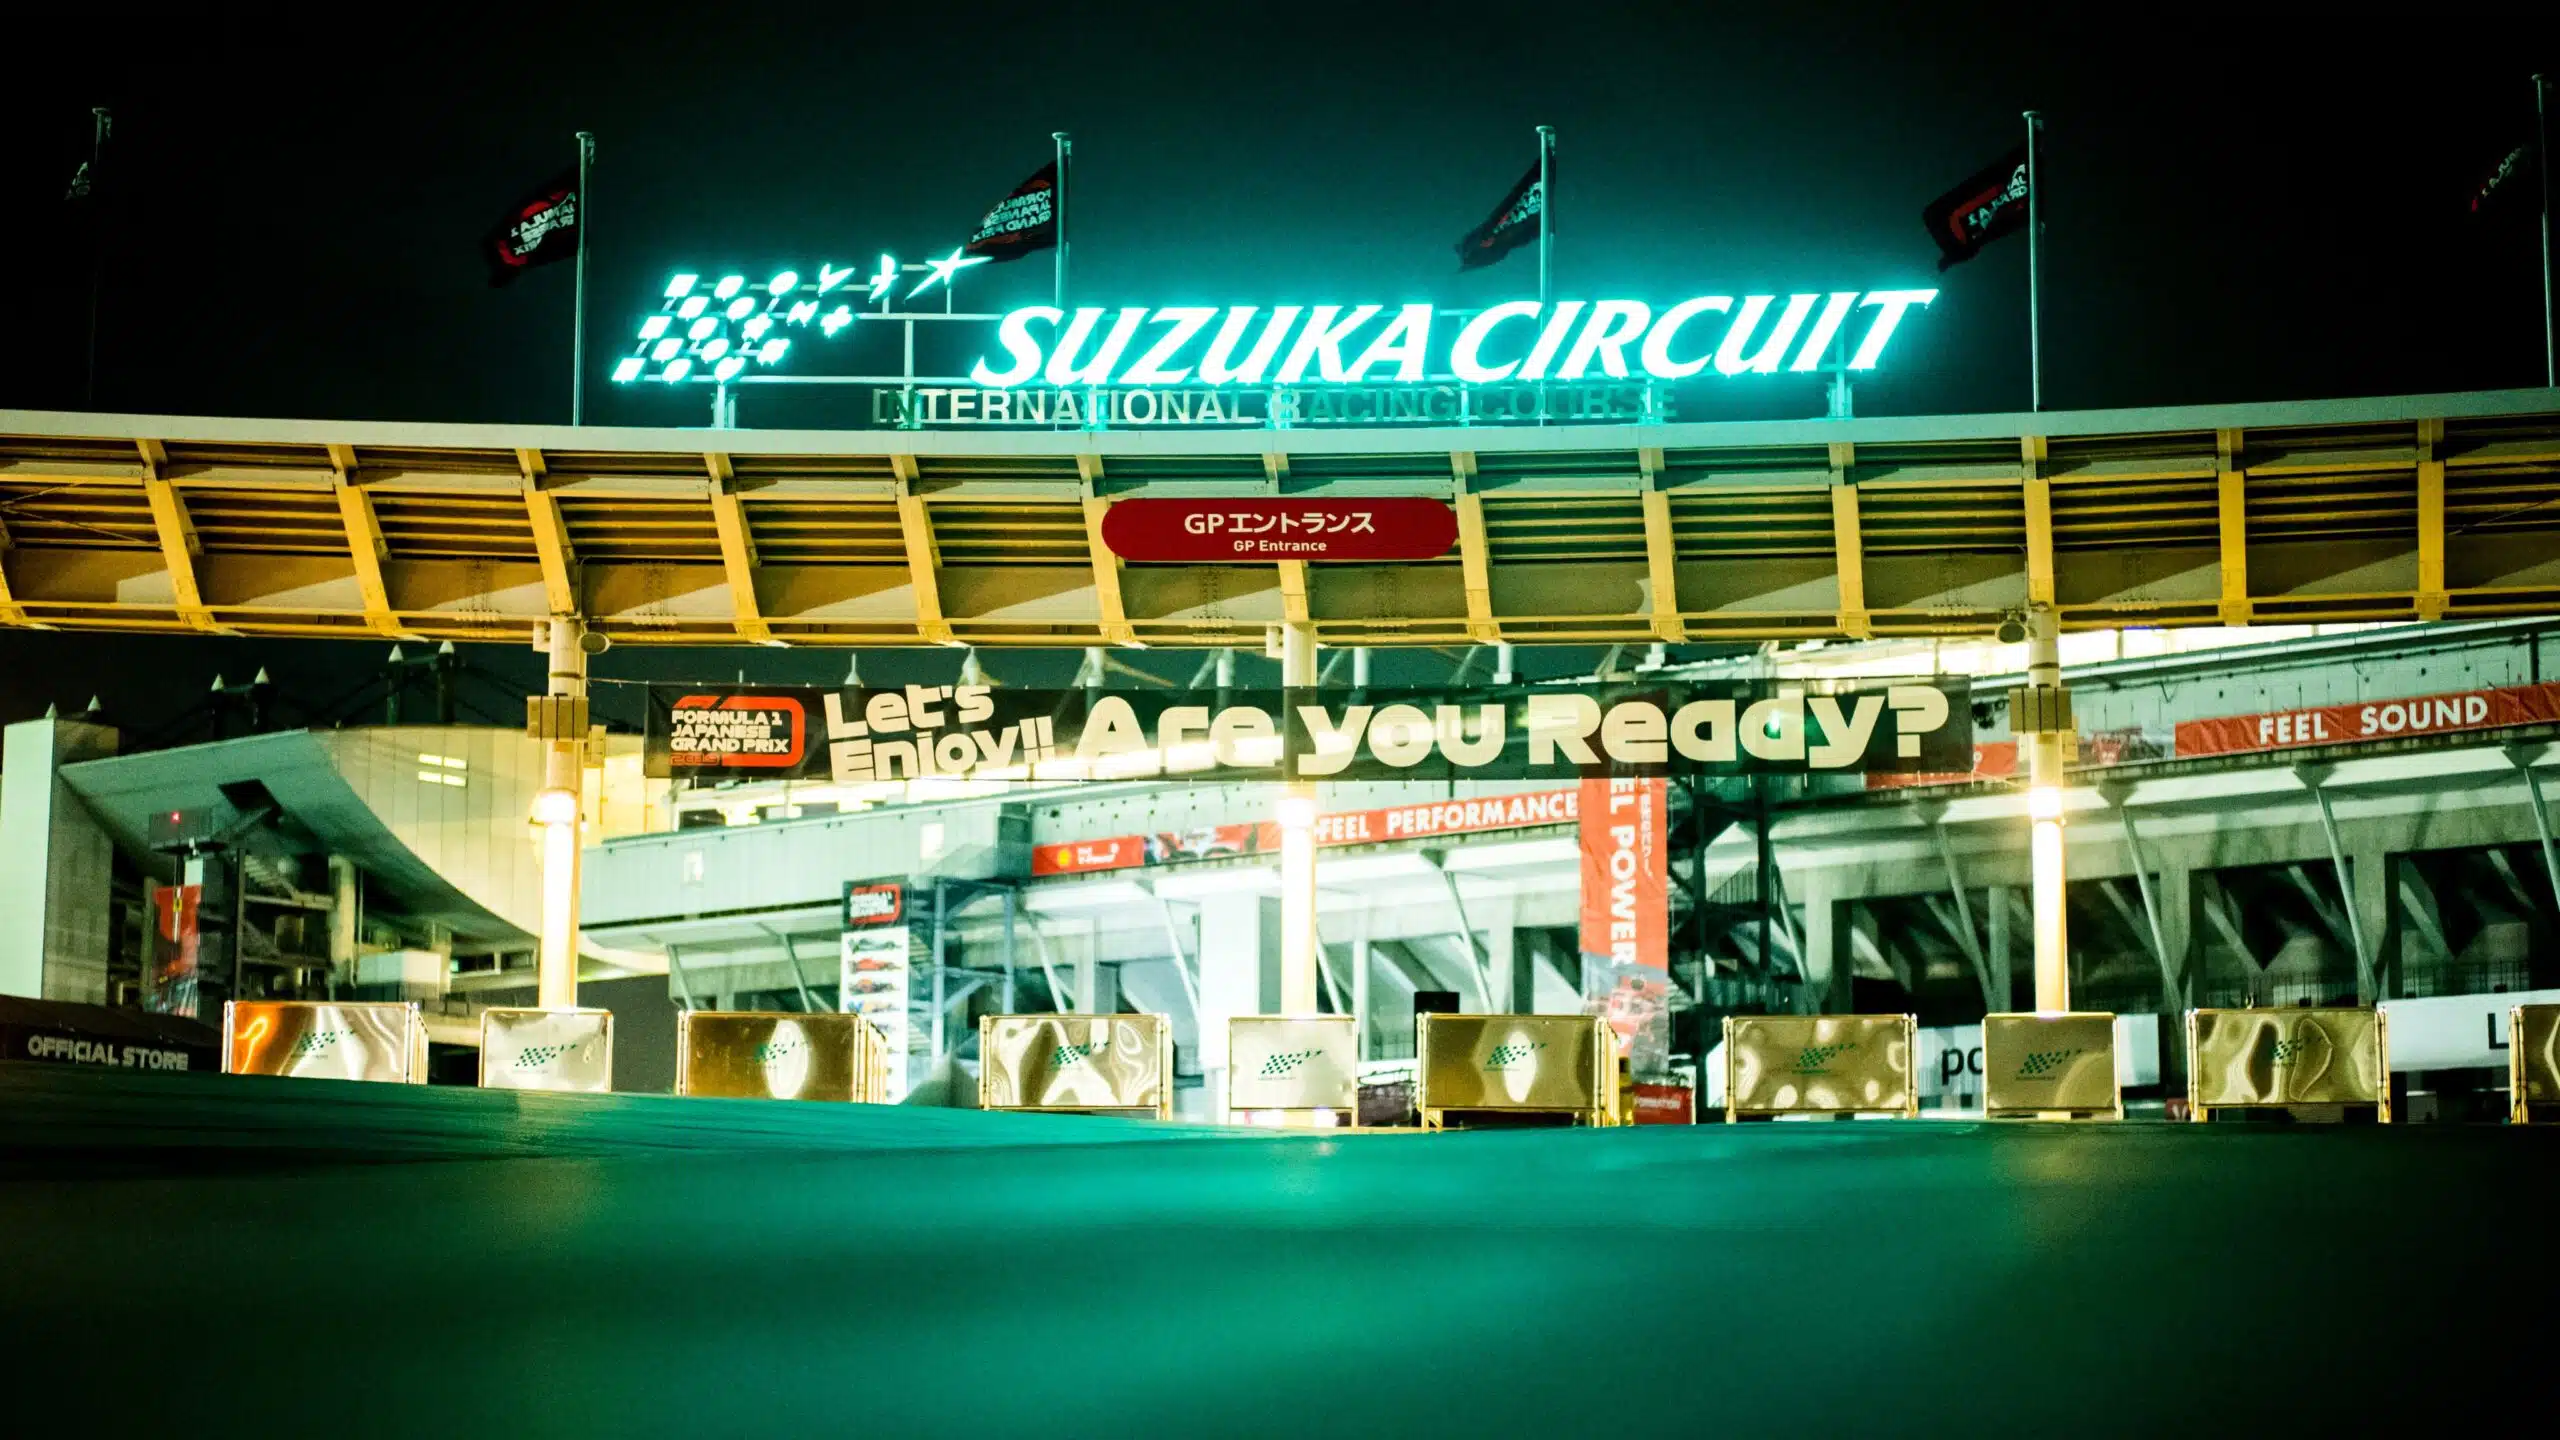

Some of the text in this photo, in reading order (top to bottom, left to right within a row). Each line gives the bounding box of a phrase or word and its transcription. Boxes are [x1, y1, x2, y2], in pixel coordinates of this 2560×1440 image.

[970, 288, 1940, 388] SUZUKA CIRCUIT
[872, 381, 1678, 425] INTERNATIONAL RACING COURSE
[1233, 540, 1328, 553] GP Entrance
[671, 710, 783, 726] FORMULA 1
[671, 724, 771, 739] JAPANESE
[823, 684, 996, 741] Let's
[1073, 685, 1949, 779] Are you Ready?
[2259, 696, 2489, 745] FEEL SOUND
[670, 738, 789, 753] GRAND PRIX
[829, 716, 1056, 782] Enjoy!!
[1316, 791, 1579, 842] FEEL PERFORMANCE
[1609, 825, 1637, 968] POWER
[27, 1034, 189, 1071] OFFICIAL STORE
